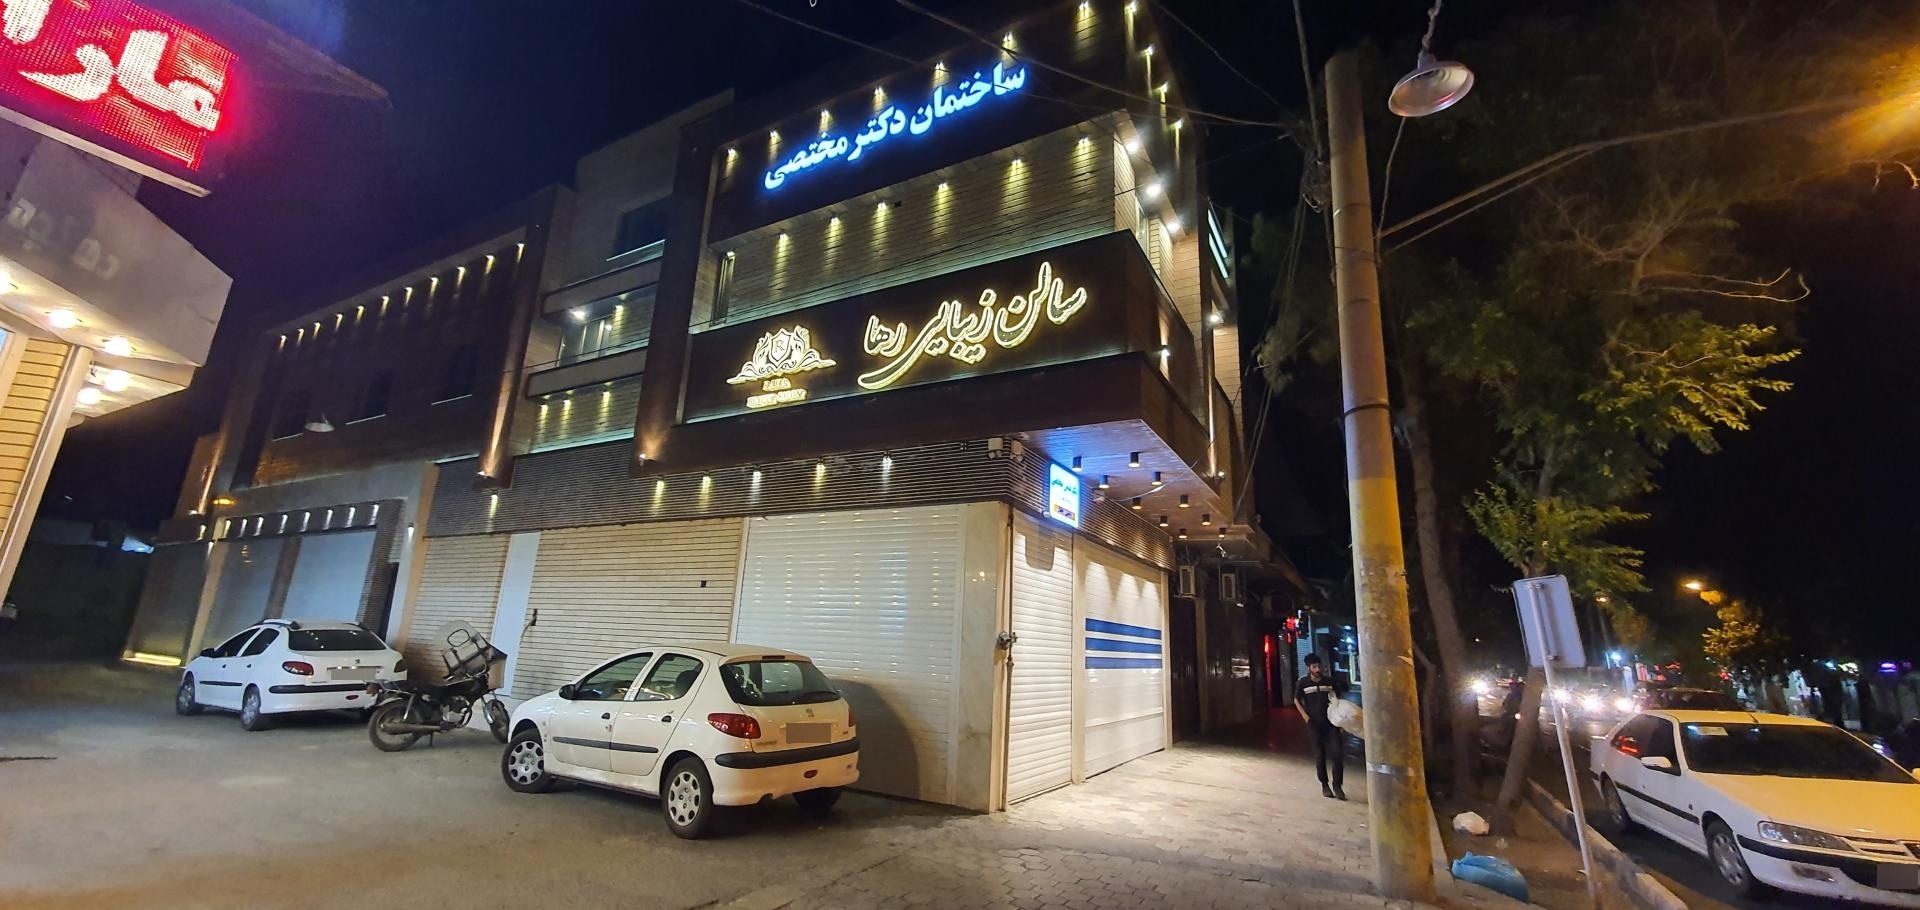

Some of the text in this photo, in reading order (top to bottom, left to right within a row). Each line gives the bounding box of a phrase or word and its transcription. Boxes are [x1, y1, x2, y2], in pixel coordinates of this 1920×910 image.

[764, 62, 1025, 190] ساختمان دکتر مختصی
[858, 261, 1088, 390] سالن زیبایی رها
